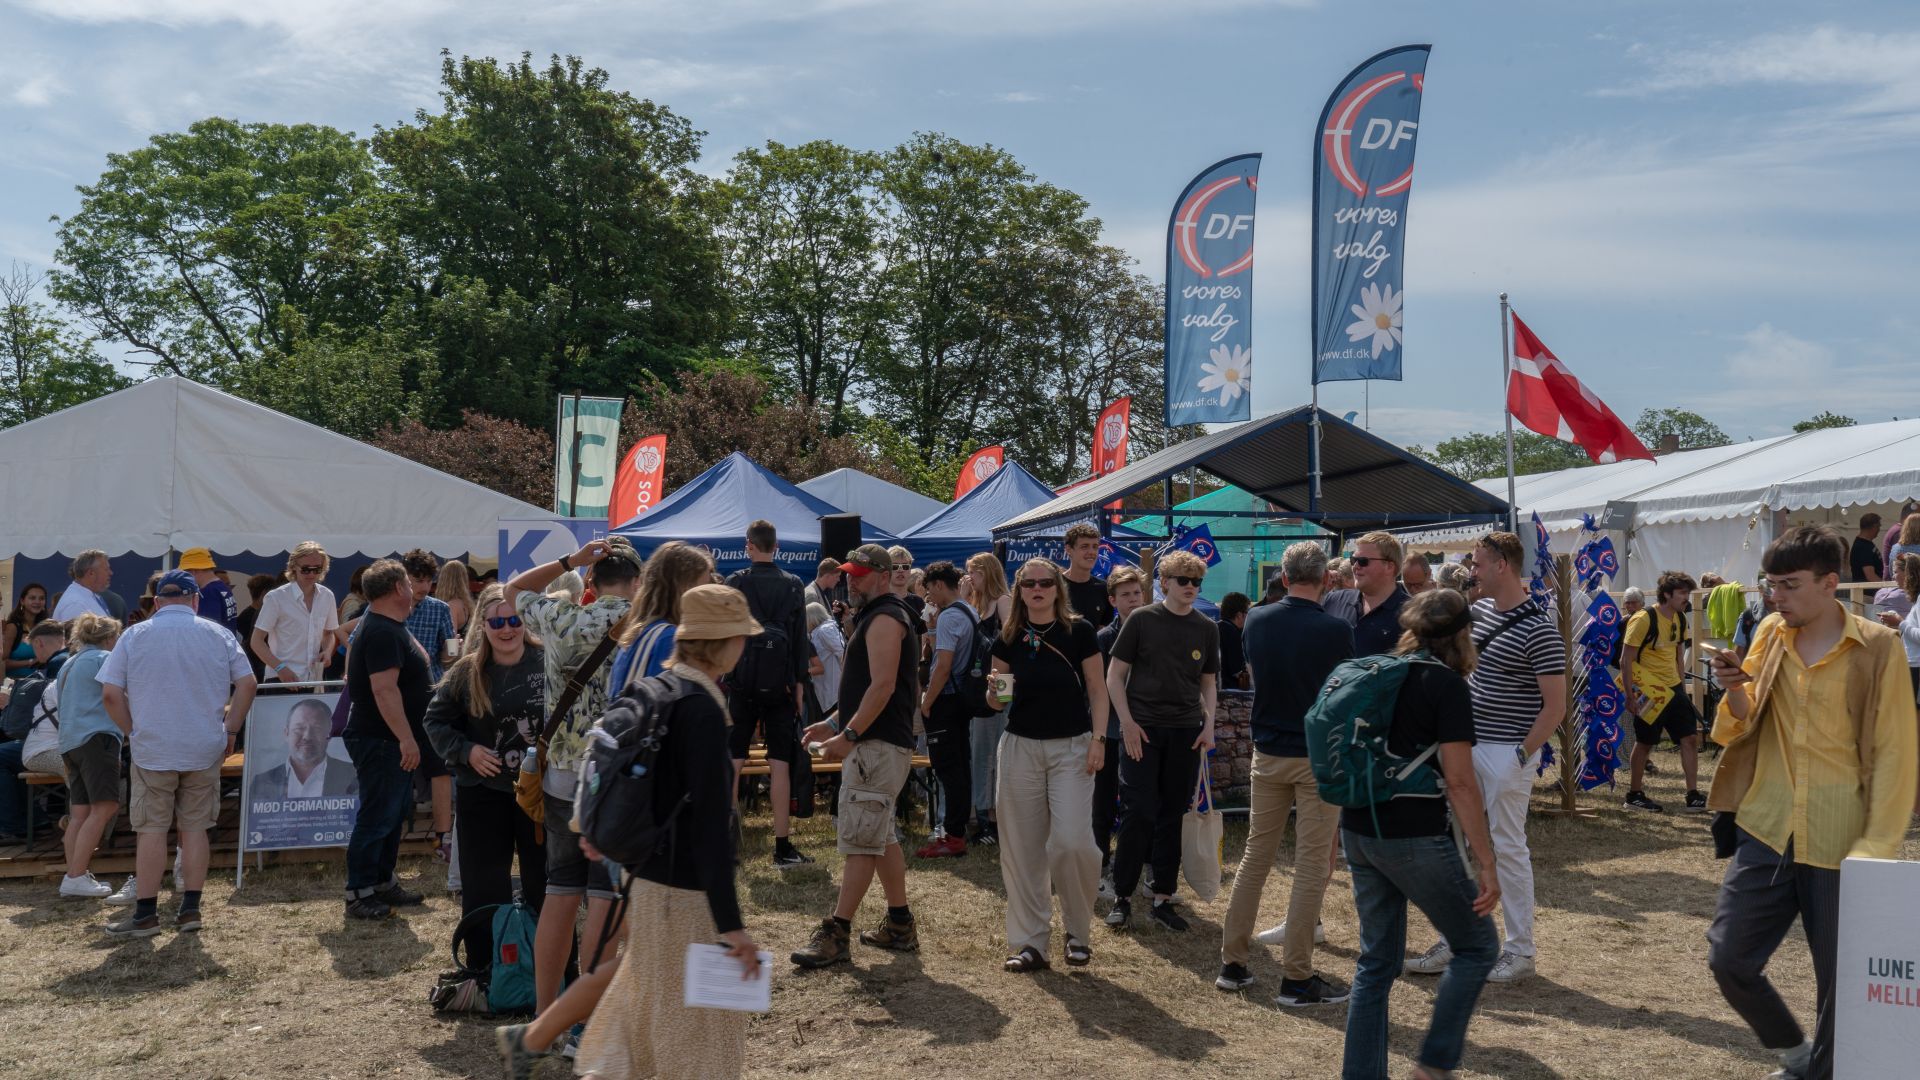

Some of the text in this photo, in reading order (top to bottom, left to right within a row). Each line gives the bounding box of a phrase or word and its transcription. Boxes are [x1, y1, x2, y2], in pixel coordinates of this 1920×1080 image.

[1360, 118, 1417, 150] DF
[1204, 213, 1254, 240] DF
[1334, 206, 1398, 227] vores
[1334, 230, 1391, 278] valg
[1182, 284, 1242, 300] vores
[1182, 302, 1240, 342] valg
[1171, 397, 1218, 410] www.df.dk
[772, 547, 818, 564] keparti
[253, 799, 355, 814] MØD FORMANDEN
[1868, 957, 1915, 980] LUNE
